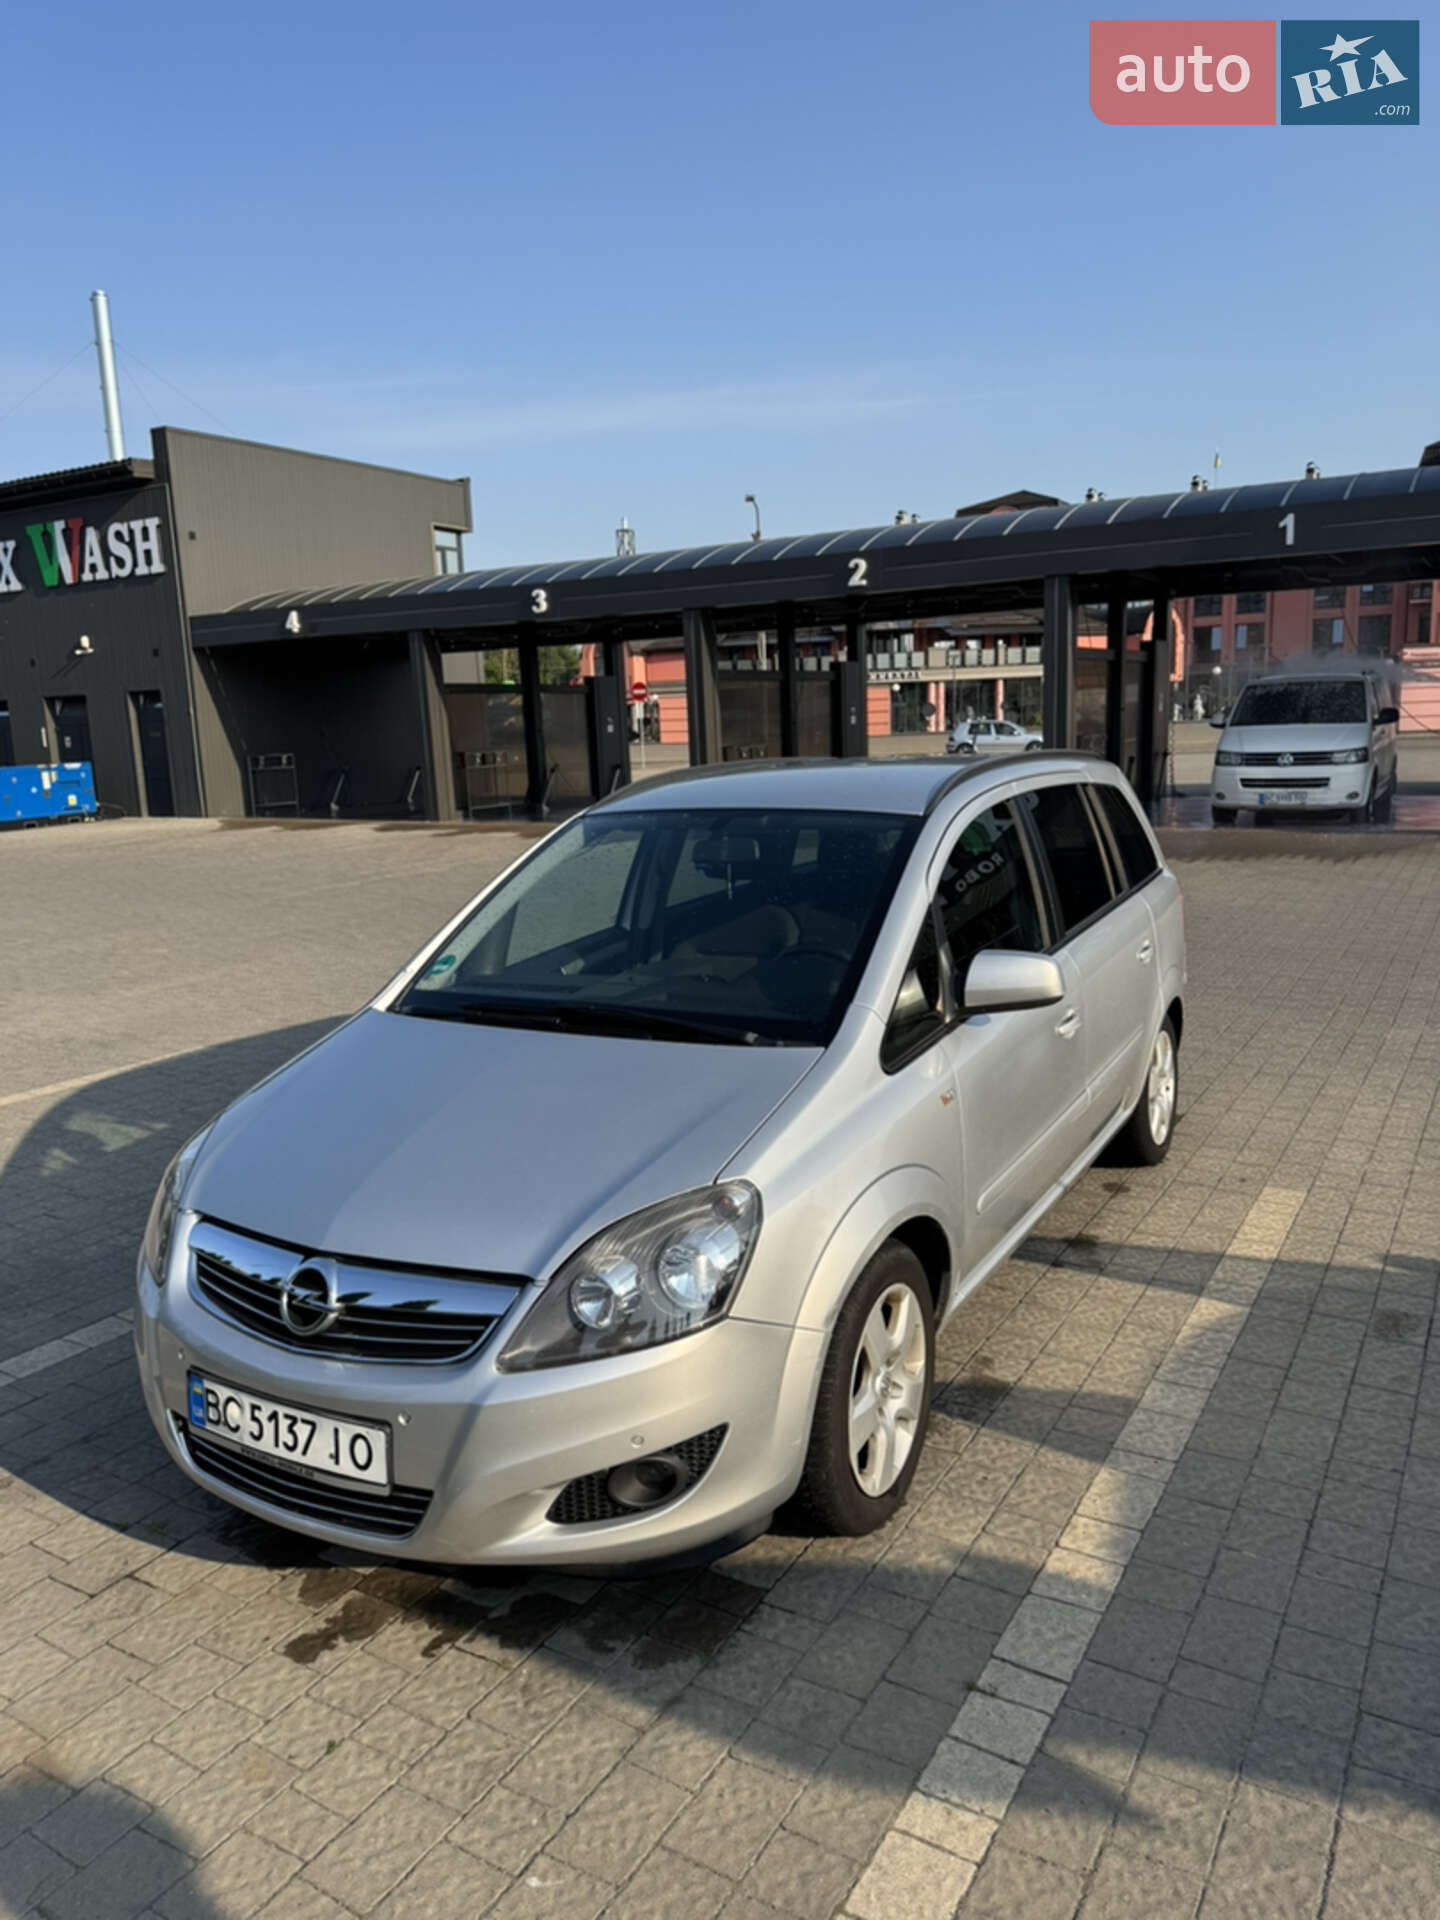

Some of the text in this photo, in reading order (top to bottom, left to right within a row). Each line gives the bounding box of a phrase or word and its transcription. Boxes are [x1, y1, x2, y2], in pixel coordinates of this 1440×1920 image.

[1278, 513, 1296, 546] 1
[25, 516, 166, 588] WASH
[847, 558, 869, 588] 2
[531, 588, 549, 614] 3
[284, 610, 302, 633] 4
[205, 1388, 242, 1433] BC
[250, 1403, 318, 1457] 5137
